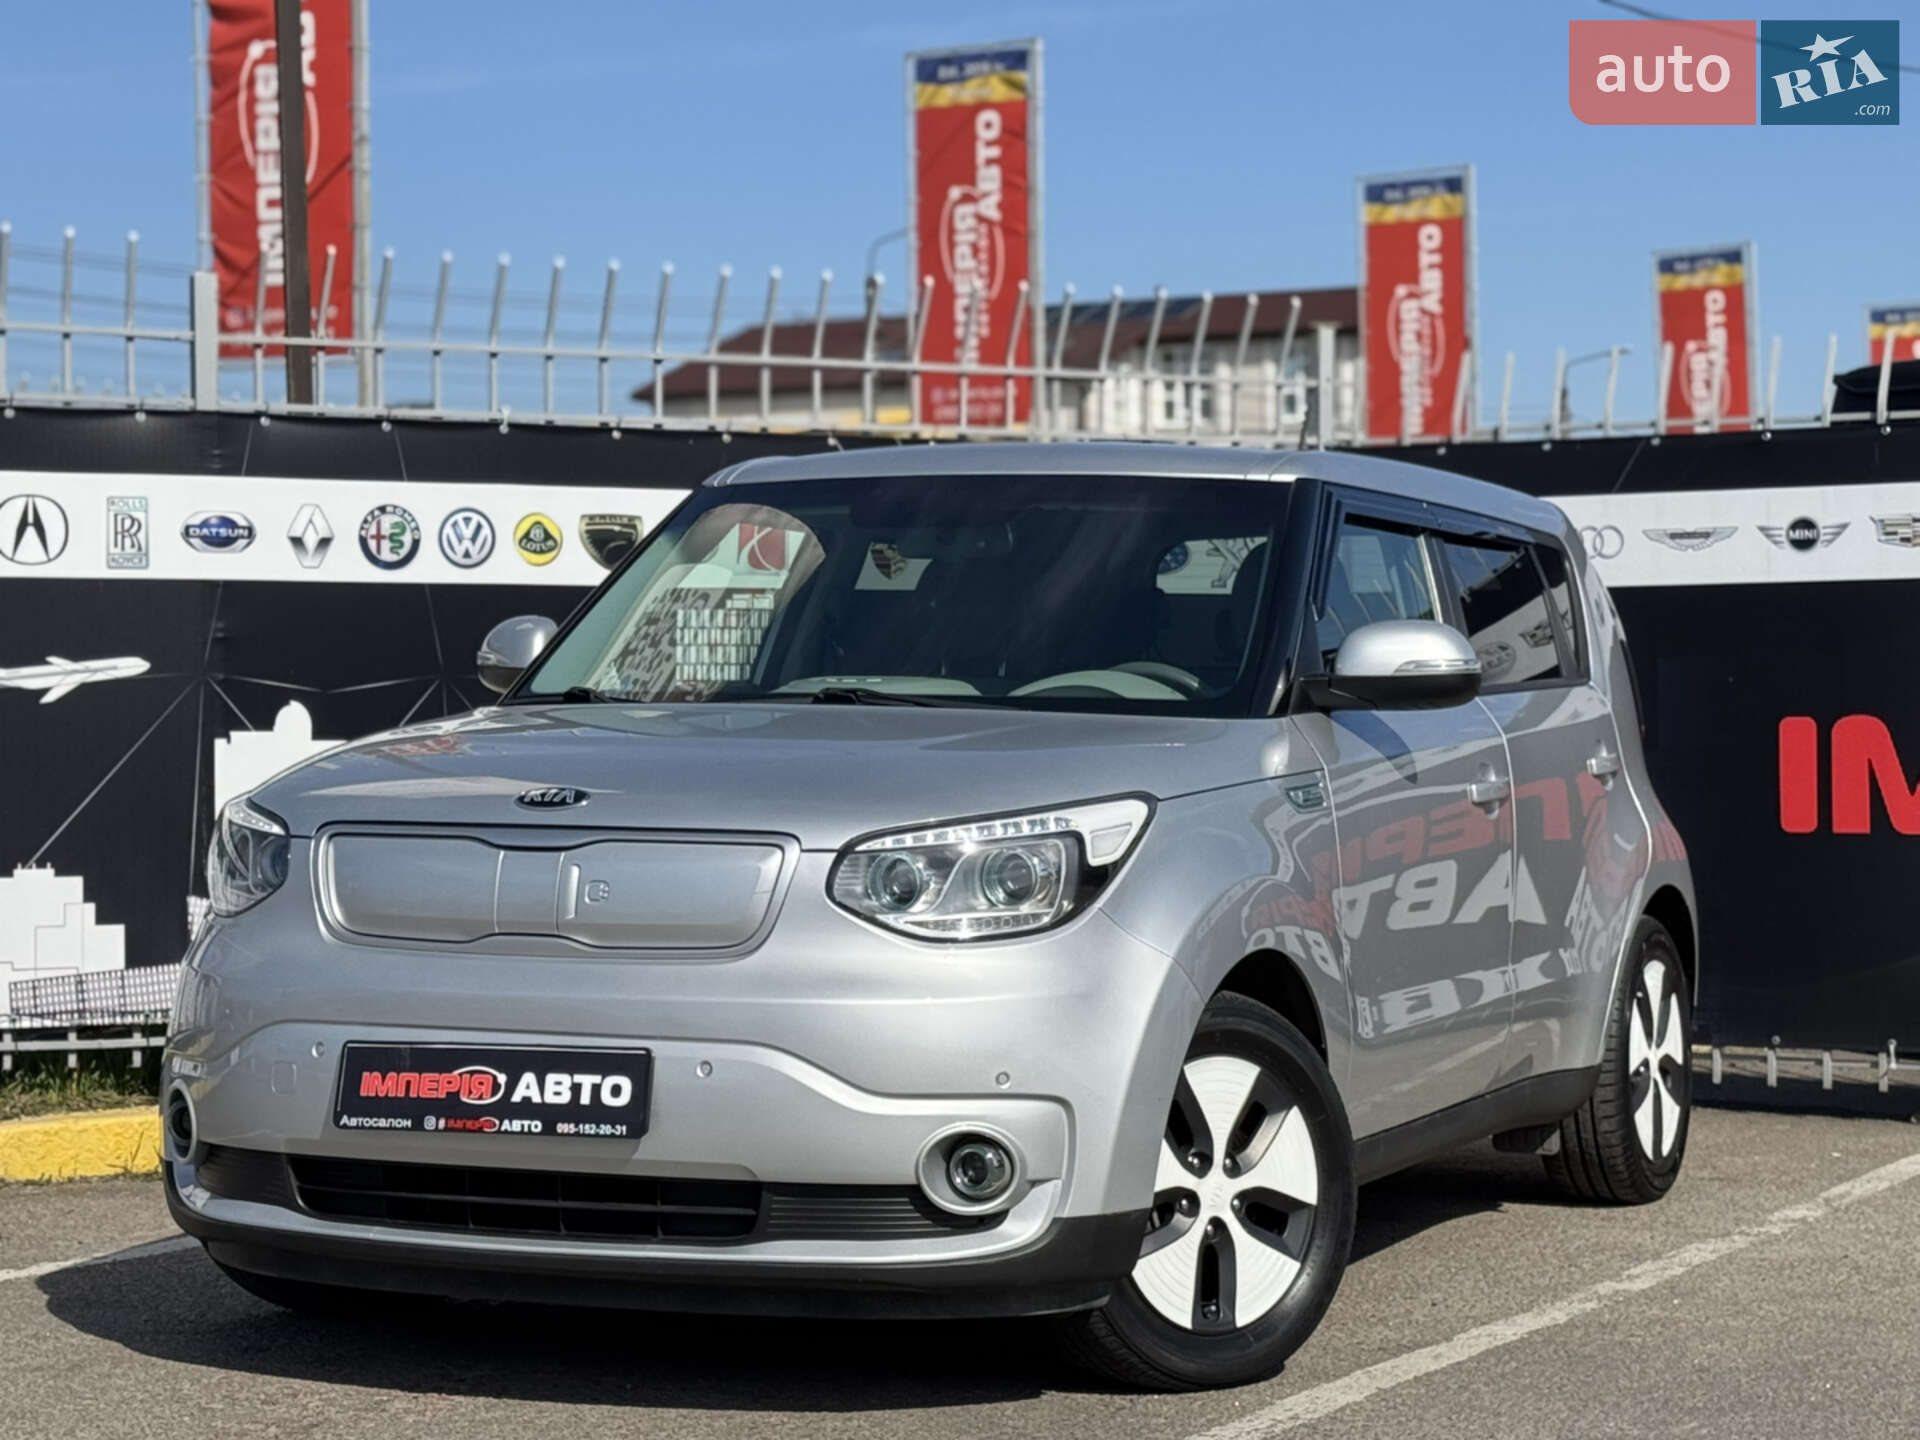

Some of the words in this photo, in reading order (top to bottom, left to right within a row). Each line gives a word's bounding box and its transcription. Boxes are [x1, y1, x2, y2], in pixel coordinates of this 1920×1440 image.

[188, 526, 250, 538] DATSUN
[1788, 528, 1818, 540] MINI
[520, 537, 558, 551] LOTUS
[523, 788, 577, 804] KIA
[360, 1071, 494, 1099] ІМПЕРІЯ
[511, 1073, 632, 1107] АВТО
[339, 1114, 412, 1128] Автосалон
[500, 1118, 543, 1133] АВТО
